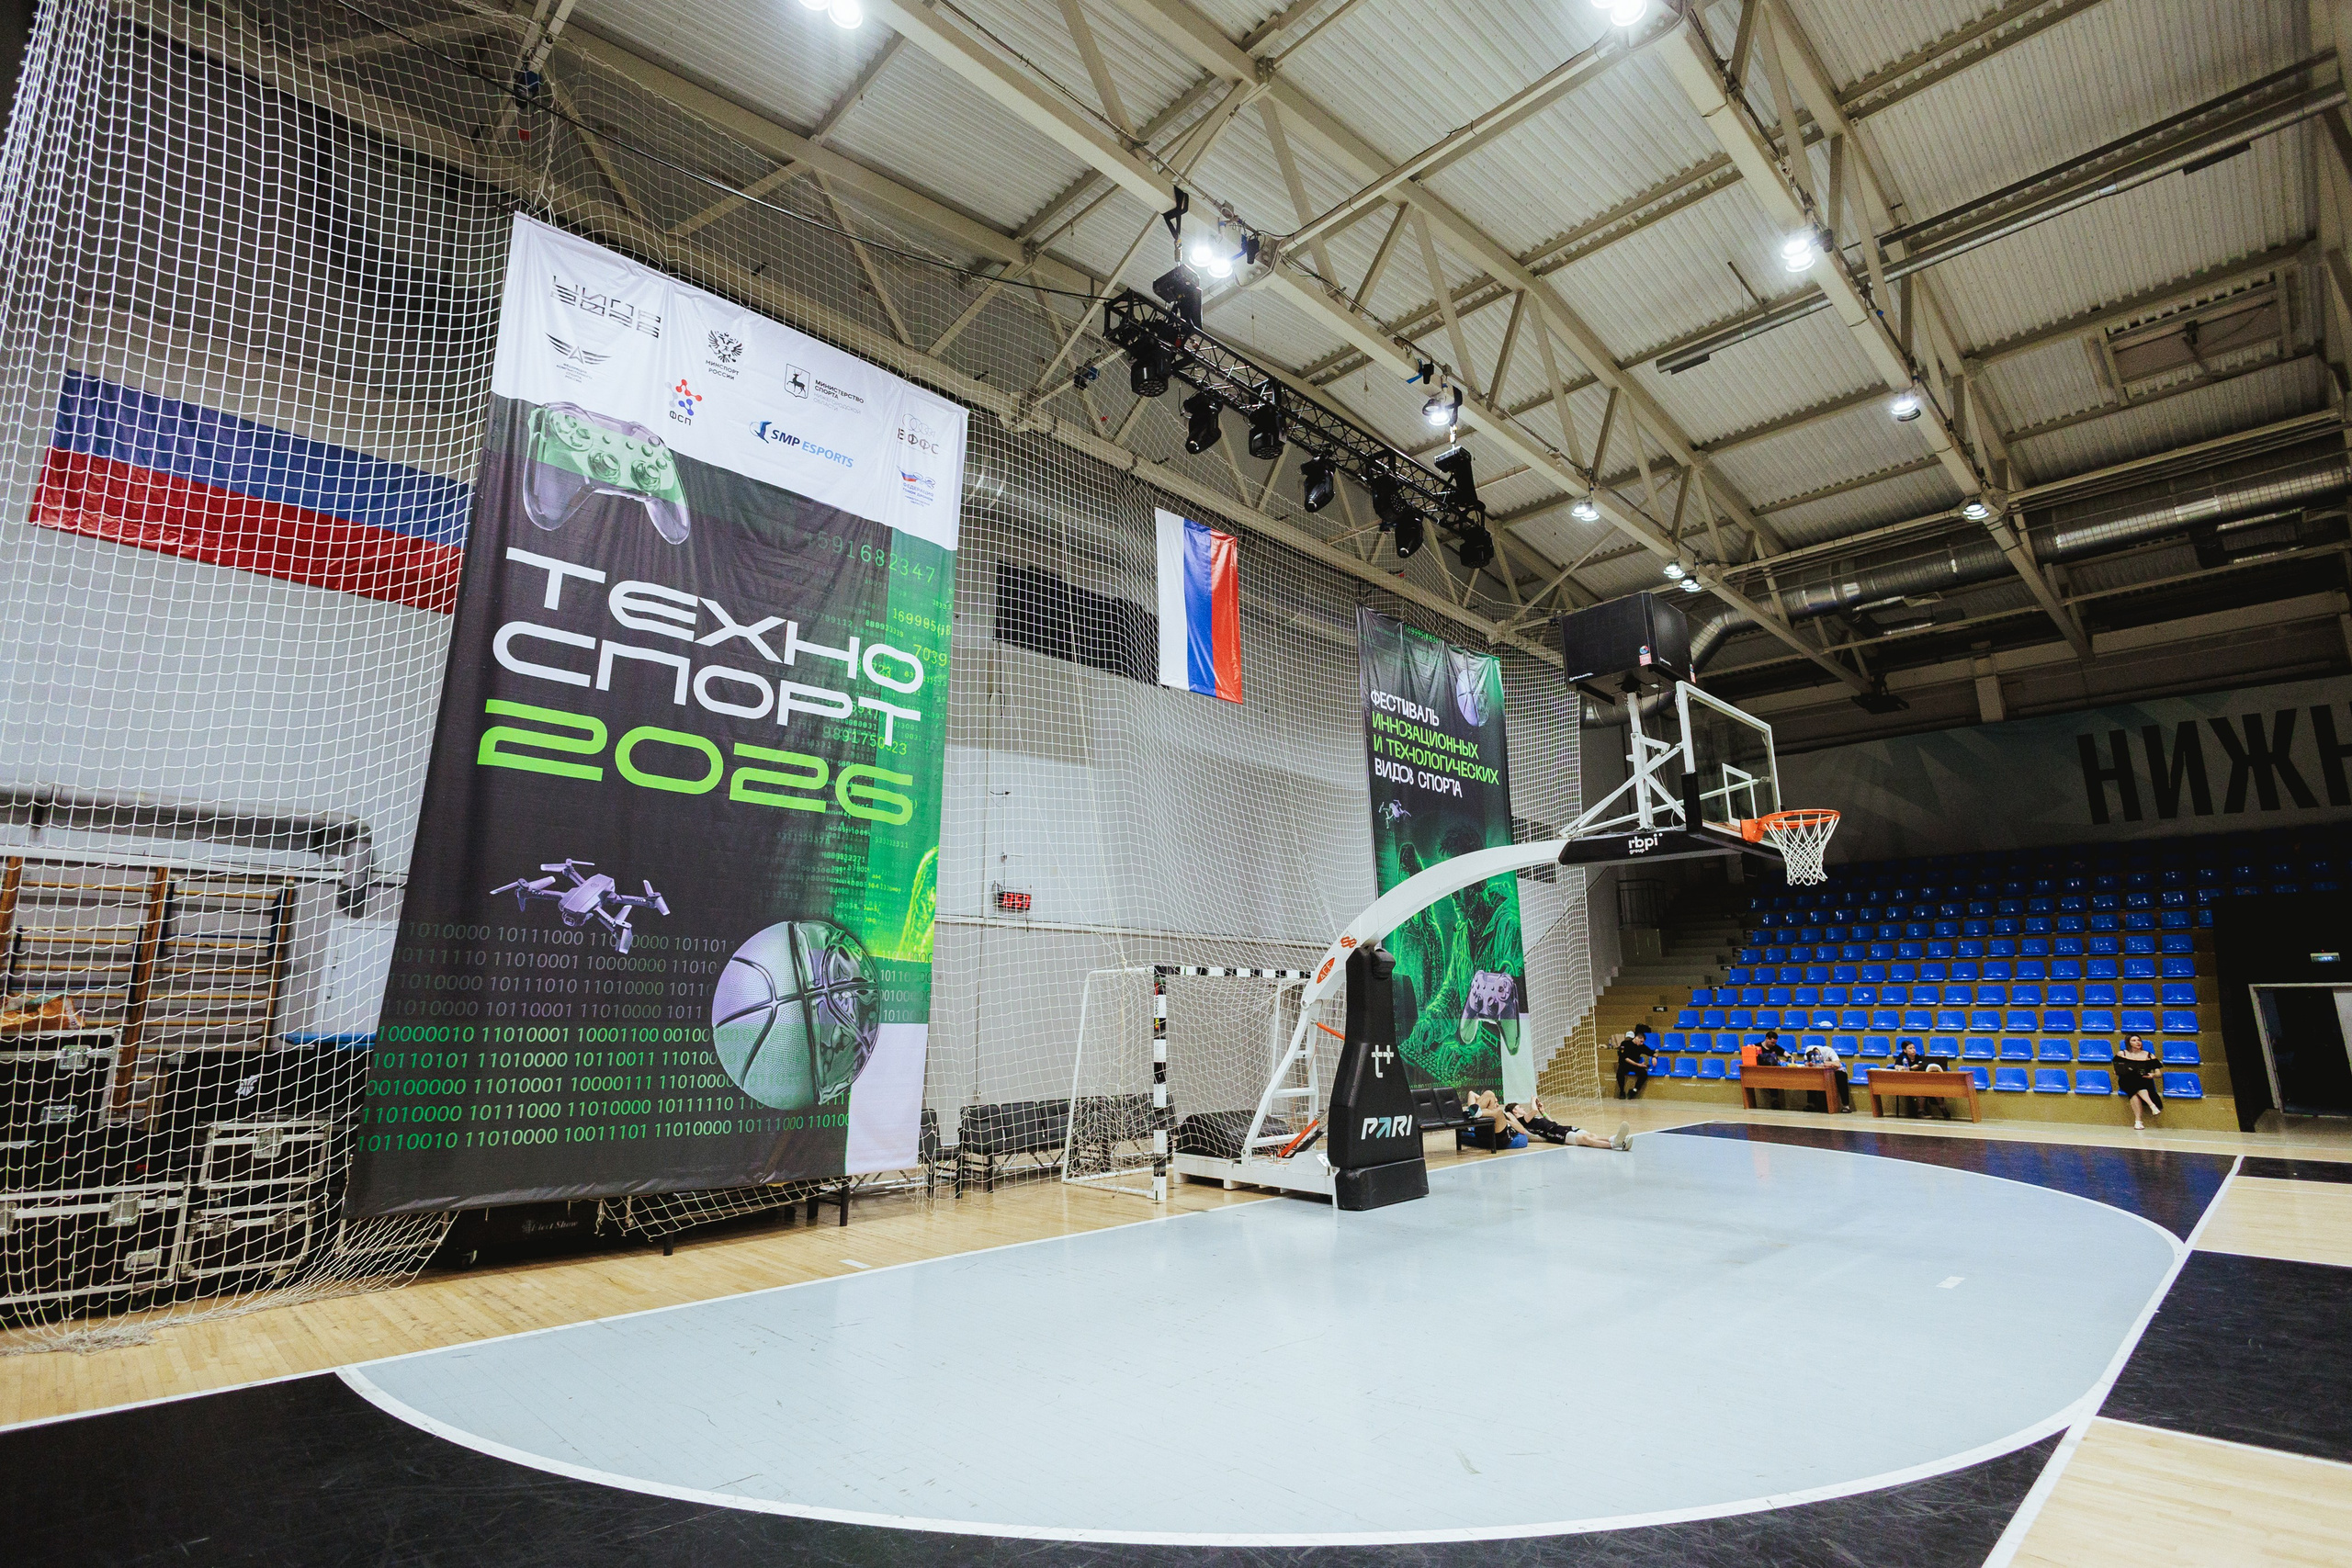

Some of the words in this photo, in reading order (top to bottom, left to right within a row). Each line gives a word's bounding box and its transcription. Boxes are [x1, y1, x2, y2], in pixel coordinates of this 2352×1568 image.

[706, 360, 739, 375] МИНСПОРТ
[708, 368, 734, 380] РОССИИ
[815, 379, 864, 403] МИНИСТЕРСТВО
[815, 386, 839, 400] СПОРТА
[813, 397, 838, 412] ОБЛАСТИ
[814, 392, 861, 414] НИЖЕГОРОДСКОЙ
[669, 411, 691, 425] ФСП
[771, 429, 800, 446] SMP
[801, 441, 854, 468] ESPORTS
[506, 547, 923, 694] ТЕХНО
[492, 621, 921, 747] СПОРТ
[1371, 689, 1439, 727] ФЕСТИВАЛЬ
[1374, 734, 1383, 753] И
[478, 699, 913, 825] 2026
[1418, 771, 1463, 798] СПОРТА
[1628, 833, 1659, 851] rbpi
[498, 926, 583, 946] 10111000
[591, 932, 669, 950] 1100000
[494, 951, 578, 970] 11010001
[587, 955, 666, 973] 10000000
[491, 976, 577, 994] 10111010
[583, 979, 664, 995] 11010000
[486, 1001, 572, 1019] 10110001
[581, 1004, 662, 1020] 11010000
[378, 1026, 475, 1043] 10000010
[482, 1027, 569, 1043] 11010001
[578, 1028, 659, 1043] 10001100
[374, 1053, 468, 1068] 10110101
[479, 1053, 568, 1068] 11010000
[574, 1052, 654, 1067] 10110011
[367, 1079, 466, 1096] 00100000
[474, 1077, 562, 1094] 11010001
[571, 1076, 651, 1091] 10000111
[362, 1105, 462, 1124] 11010000
[470, 1103, 561, 1121] 10111000
[568, 1100, 651, 1117] 11010000
[658, 1097, 734, 1113] 10111110
[357, 1133, 458, 1152] 10110010
[466, 1129, 558, 1148] 11010000
[564, 1123, 647, 1142] 10011101
[655, 1120, 732, 1138] 11010000
[738, 1116, 804, 1133] 10111000
[1361, 1114, 1413, 1140] PARI
